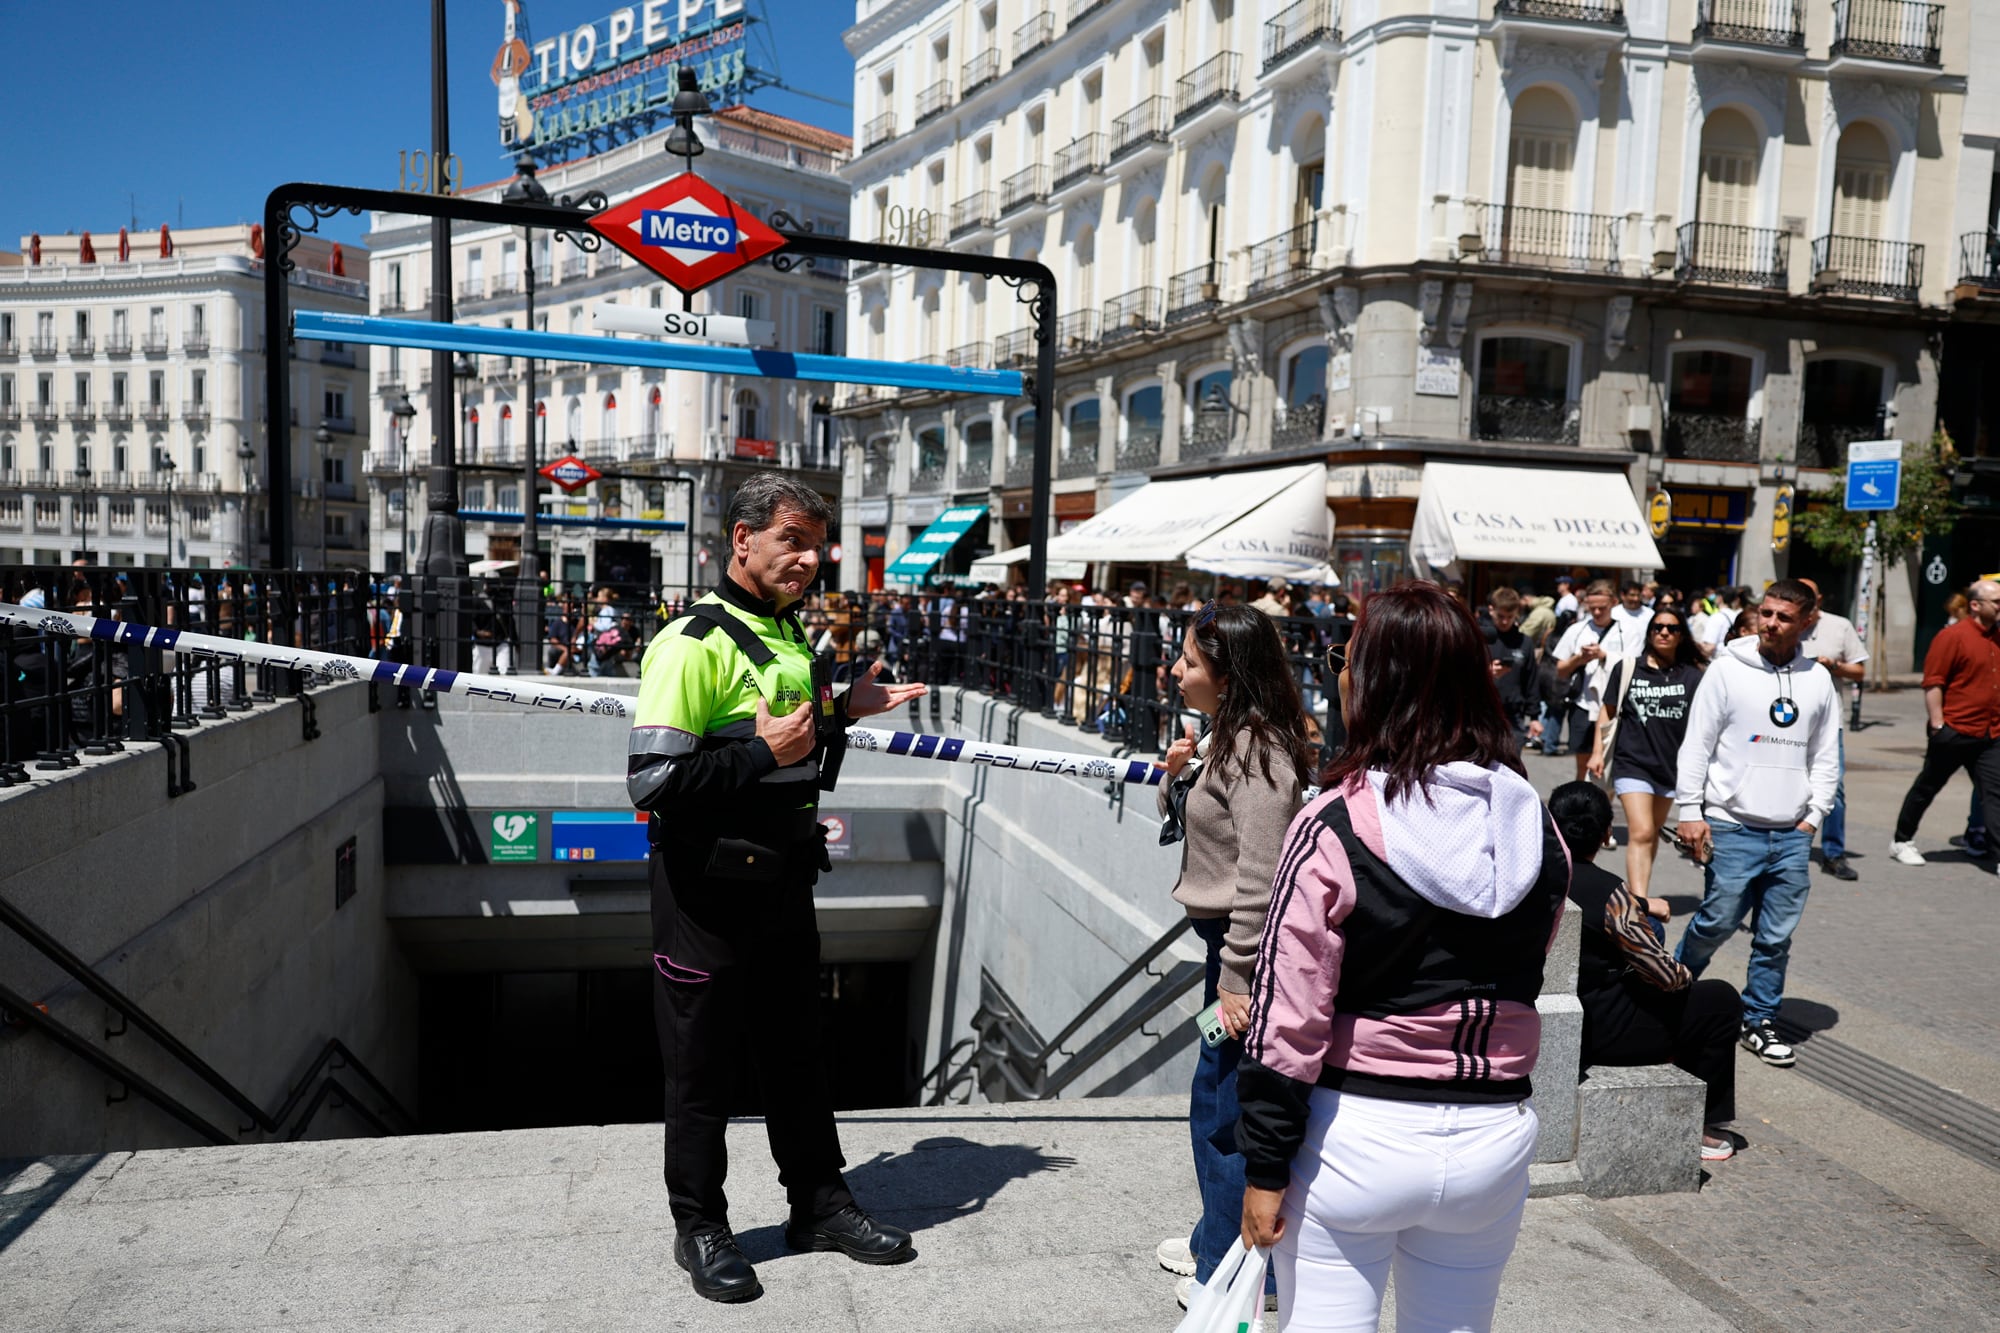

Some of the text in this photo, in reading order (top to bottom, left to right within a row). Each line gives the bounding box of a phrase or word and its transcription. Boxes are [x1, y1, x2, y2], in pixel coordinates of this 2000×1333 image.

[534, 24, 597, 85] TIO
[667, 48, 745, 102] BASS
[557, 84, 572, 101] DE
[398, 148, 463, 195] 1919
[650, 214, 731, 246] Metro
[880, 204, 932, 248] 1919
[663, 313, 708, 337] Sol
[556, 467, 584, 480] Metro
[1453, 511, 1525, 530] CASA
[1553, 518, 1641, 536] DIEGO
[1221, 539, 1270, 553] CASA
[1288, 541, 1328, 560] DIEGO
[465, 686, 584, 713] POLICÍA
[970, 752, 1078, 776] POLICÍA
[571, 848, 579, 858] 2
[585, 848, 592, 858] 3
